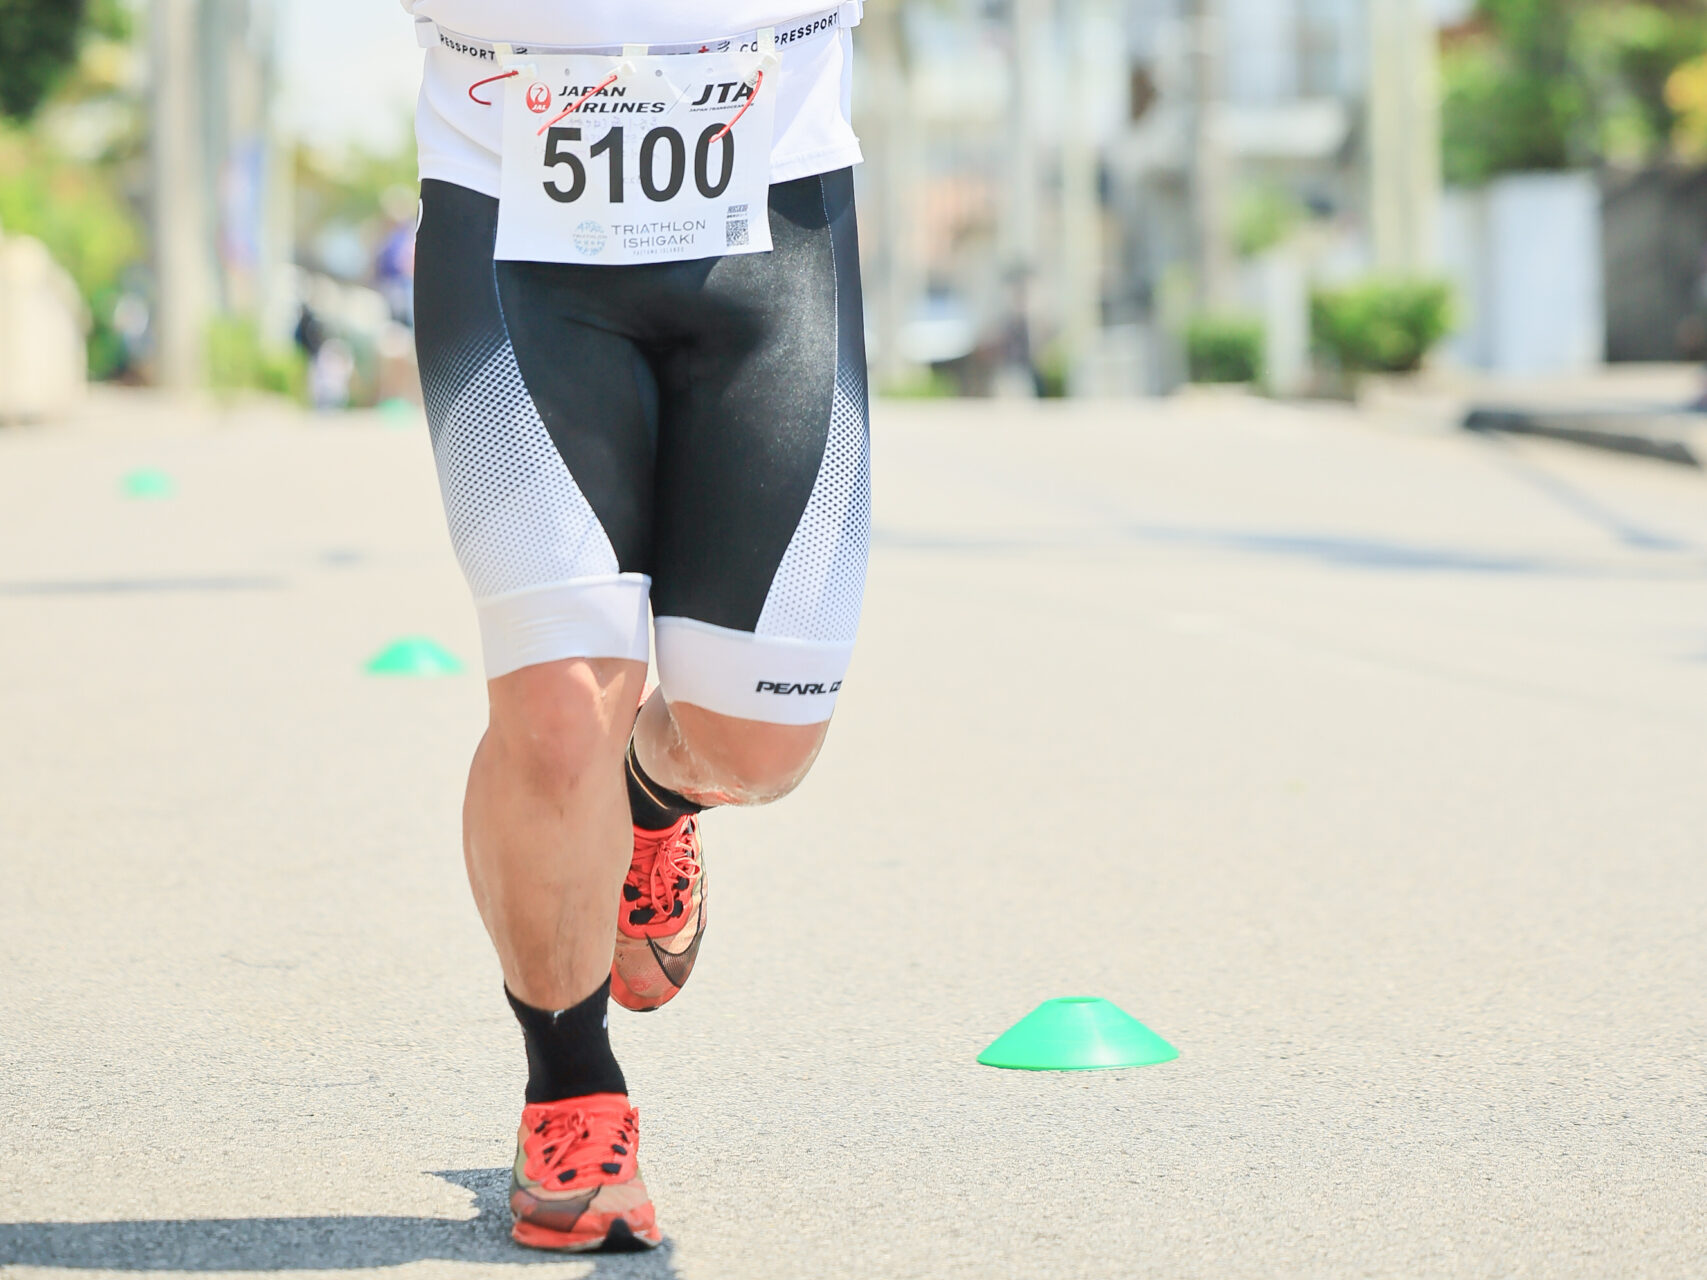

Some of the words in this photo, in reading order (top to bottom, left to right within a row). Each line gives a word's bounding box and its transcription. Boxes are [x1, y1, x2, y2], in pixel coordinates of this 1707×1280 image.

[740, 12, 838, 52] COPRESSPORT
[558, 86, 627, 97] JAPAN
[691, 82, 755, 106] JTA
[531, 103, 547, 112] JAL
[562, 102, 666, 114] AIRLINES
[542, 123, 735, 205] 5100
[611, 219, 706, 236] TRIATHLON
[623, 233, 695, 249] ISHIGAKI
[756, 680, 827, 695] PEARL
